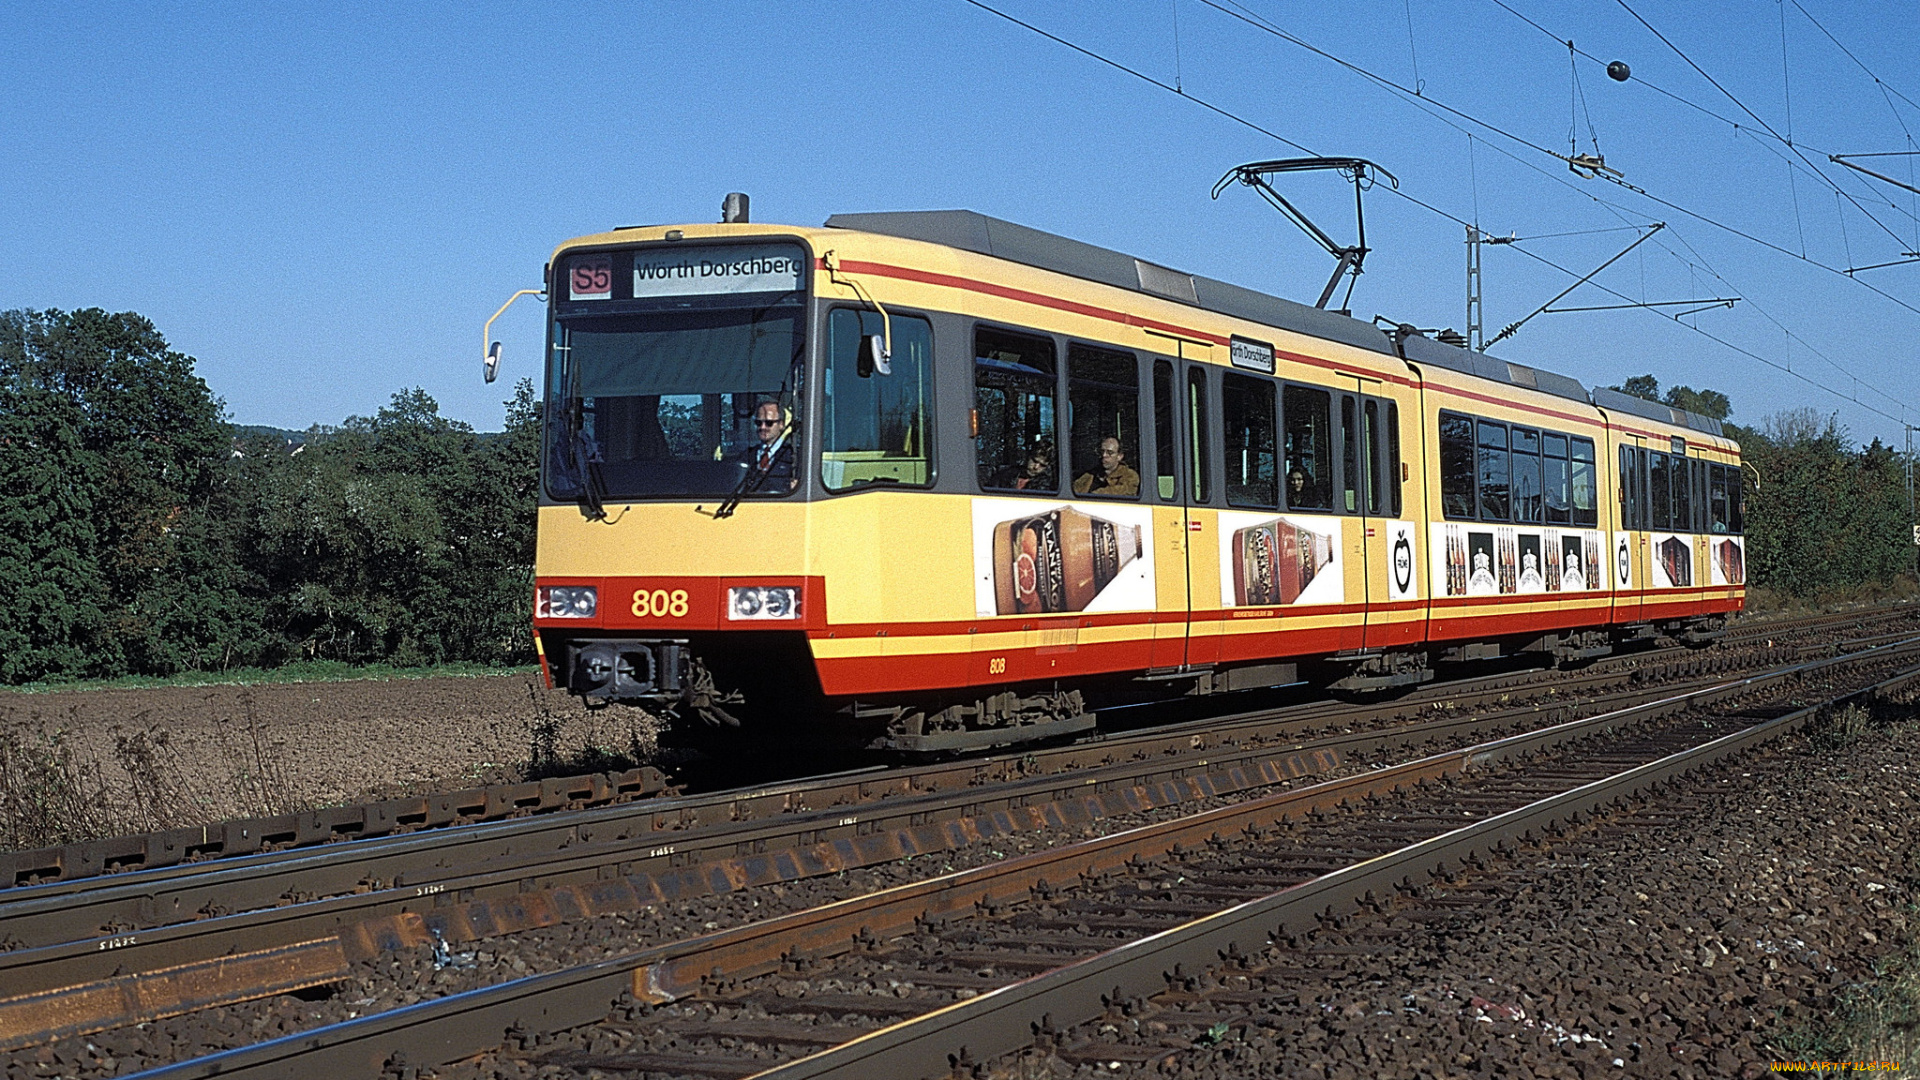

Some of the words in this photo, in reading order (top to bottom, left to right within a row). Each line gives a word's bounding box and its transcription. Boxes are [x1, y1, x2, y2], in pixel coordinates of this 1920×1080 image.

[576, 264, 608, 289] S5
[637, 260, 694, 280] Wörth
[700, 255, 802, 278] Dorschberg
[631, 588, 689, 617] 808
[989, 657, 1006, 675] 808
